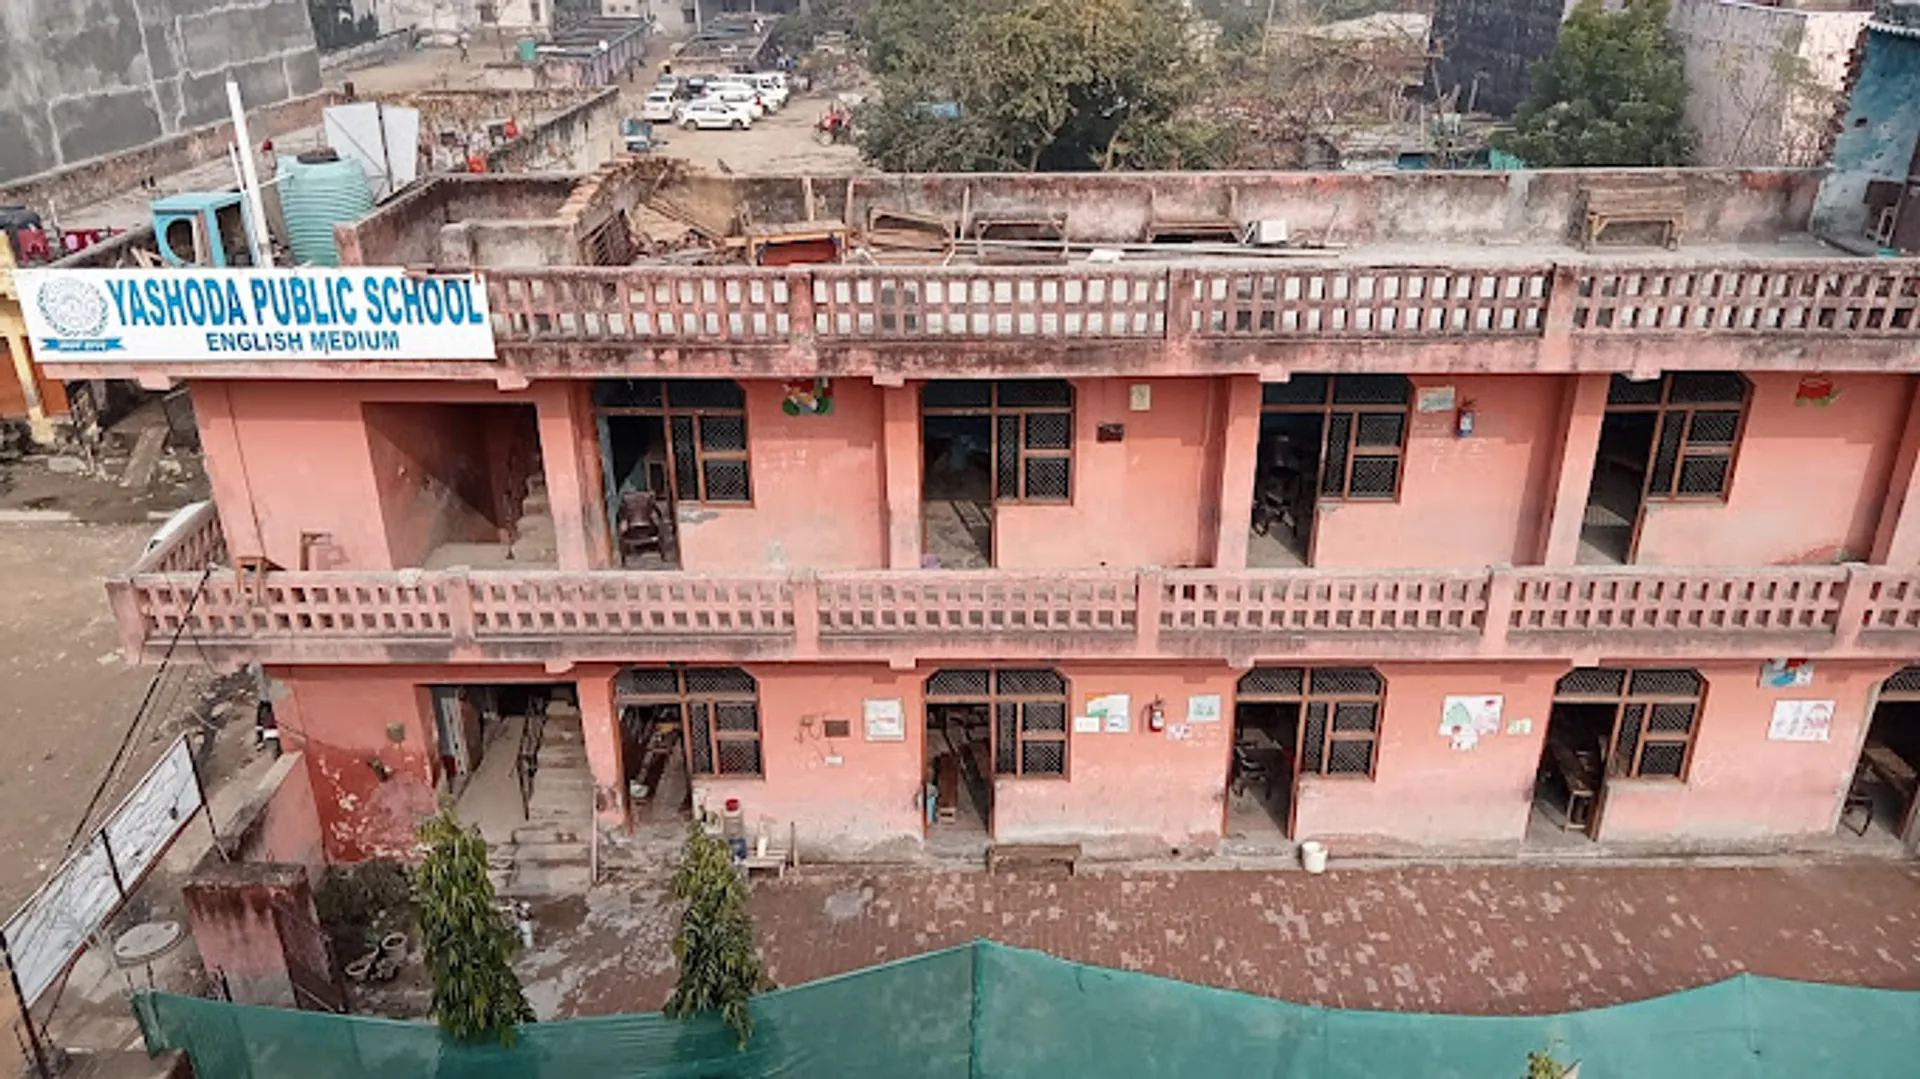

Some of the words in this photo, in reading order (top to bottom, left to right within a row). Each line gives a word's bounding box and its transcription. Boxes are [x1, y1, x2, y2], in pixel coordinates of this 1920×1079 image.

[105, 277, 247, 326] YASHODA
[250, 276, 357, 325] PUBLIC
[365, 276, 484, 325] SCHOOL
[206, 331, 304, 352] ENGLISH
[311, 330, 401, 353] MEDIUM
